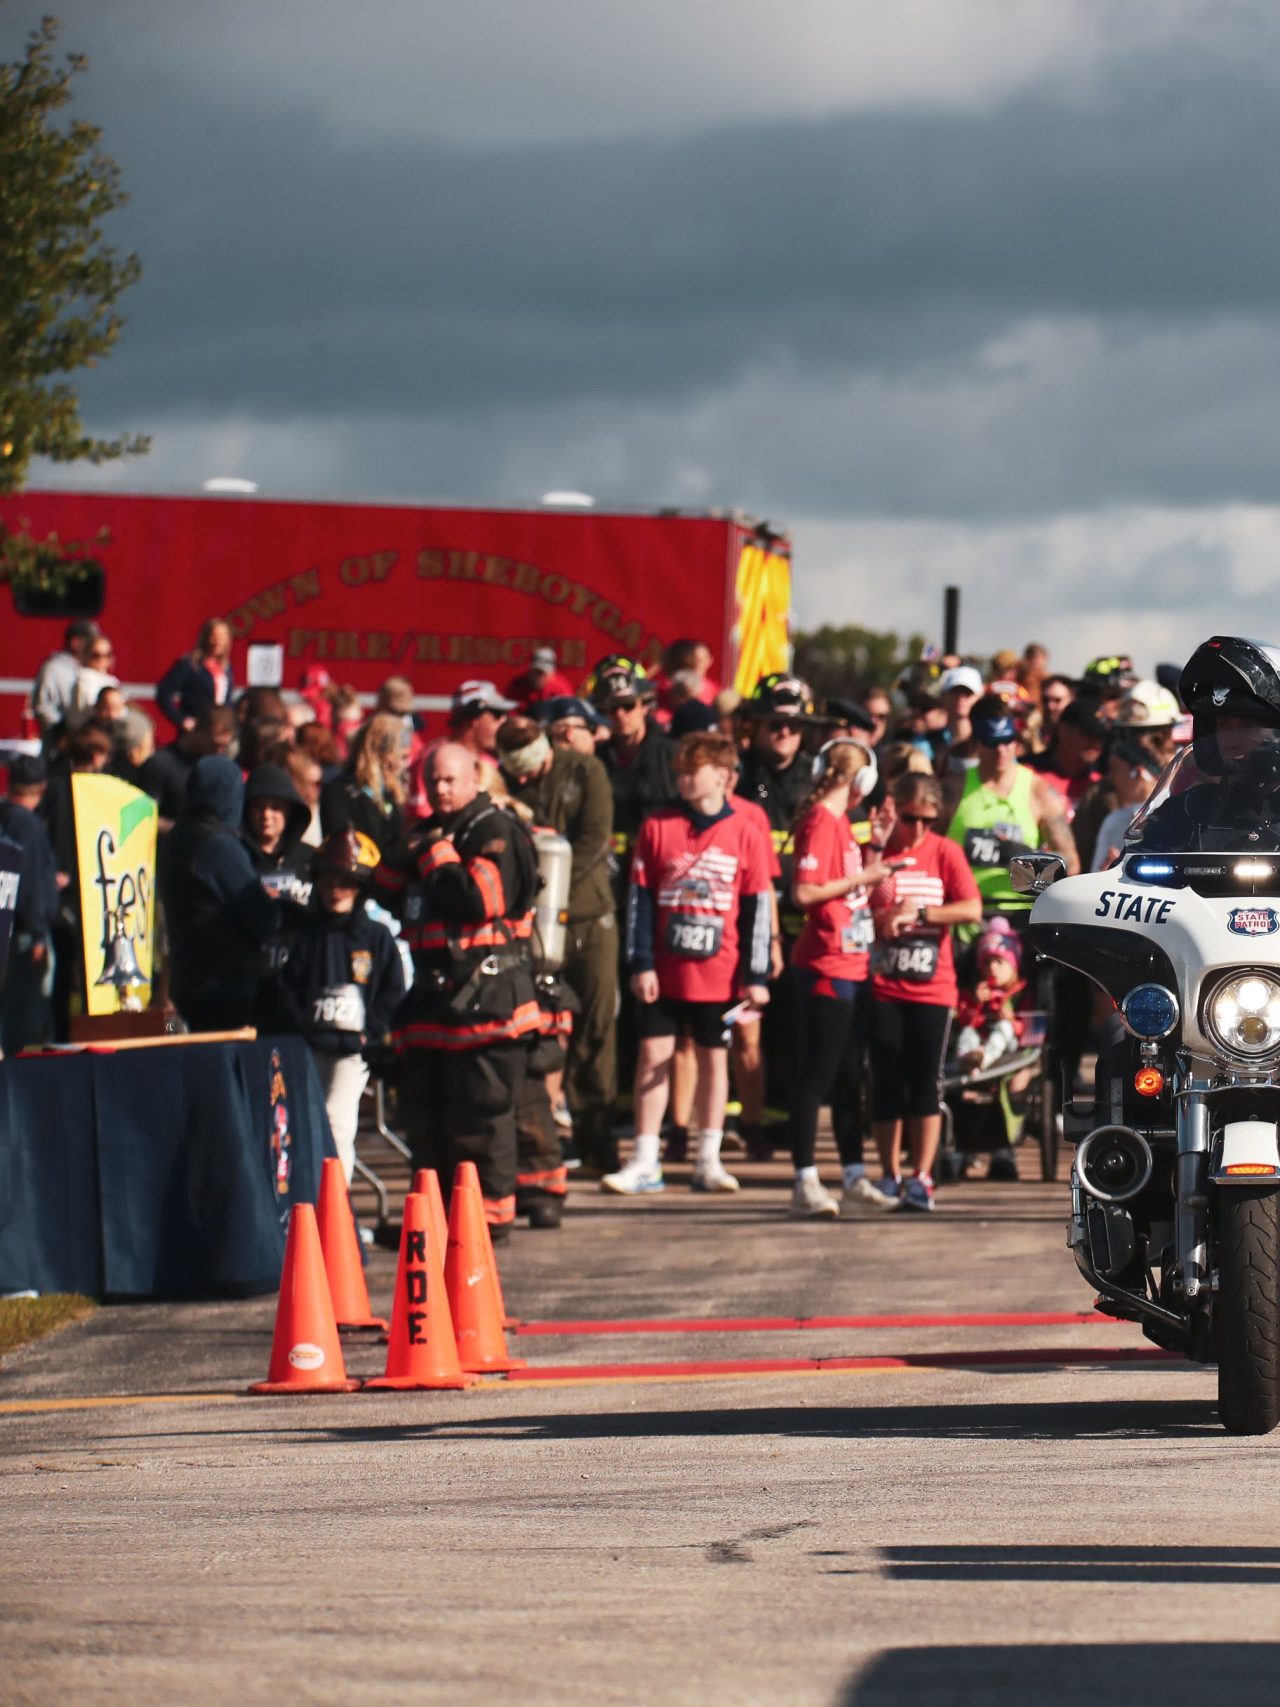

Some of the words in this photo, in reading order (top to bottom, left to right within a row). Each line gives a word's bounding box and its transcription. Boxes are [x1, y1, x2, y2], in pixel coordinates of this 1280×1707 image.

[224, 567, 321, 638] OWN
[339, 550, 399, 587] OF
[95, 829, 151, 945] fes
[1095, 890, 1176, 924] STATE
[1237, 911, 1269, 921] STATE
[671, 924, 716, 951] 7921
[1235, 920, 1273, 929] PATROL
[884, 947, 933, 974] 7842
[406, 1230, 428, 1346] RDE
